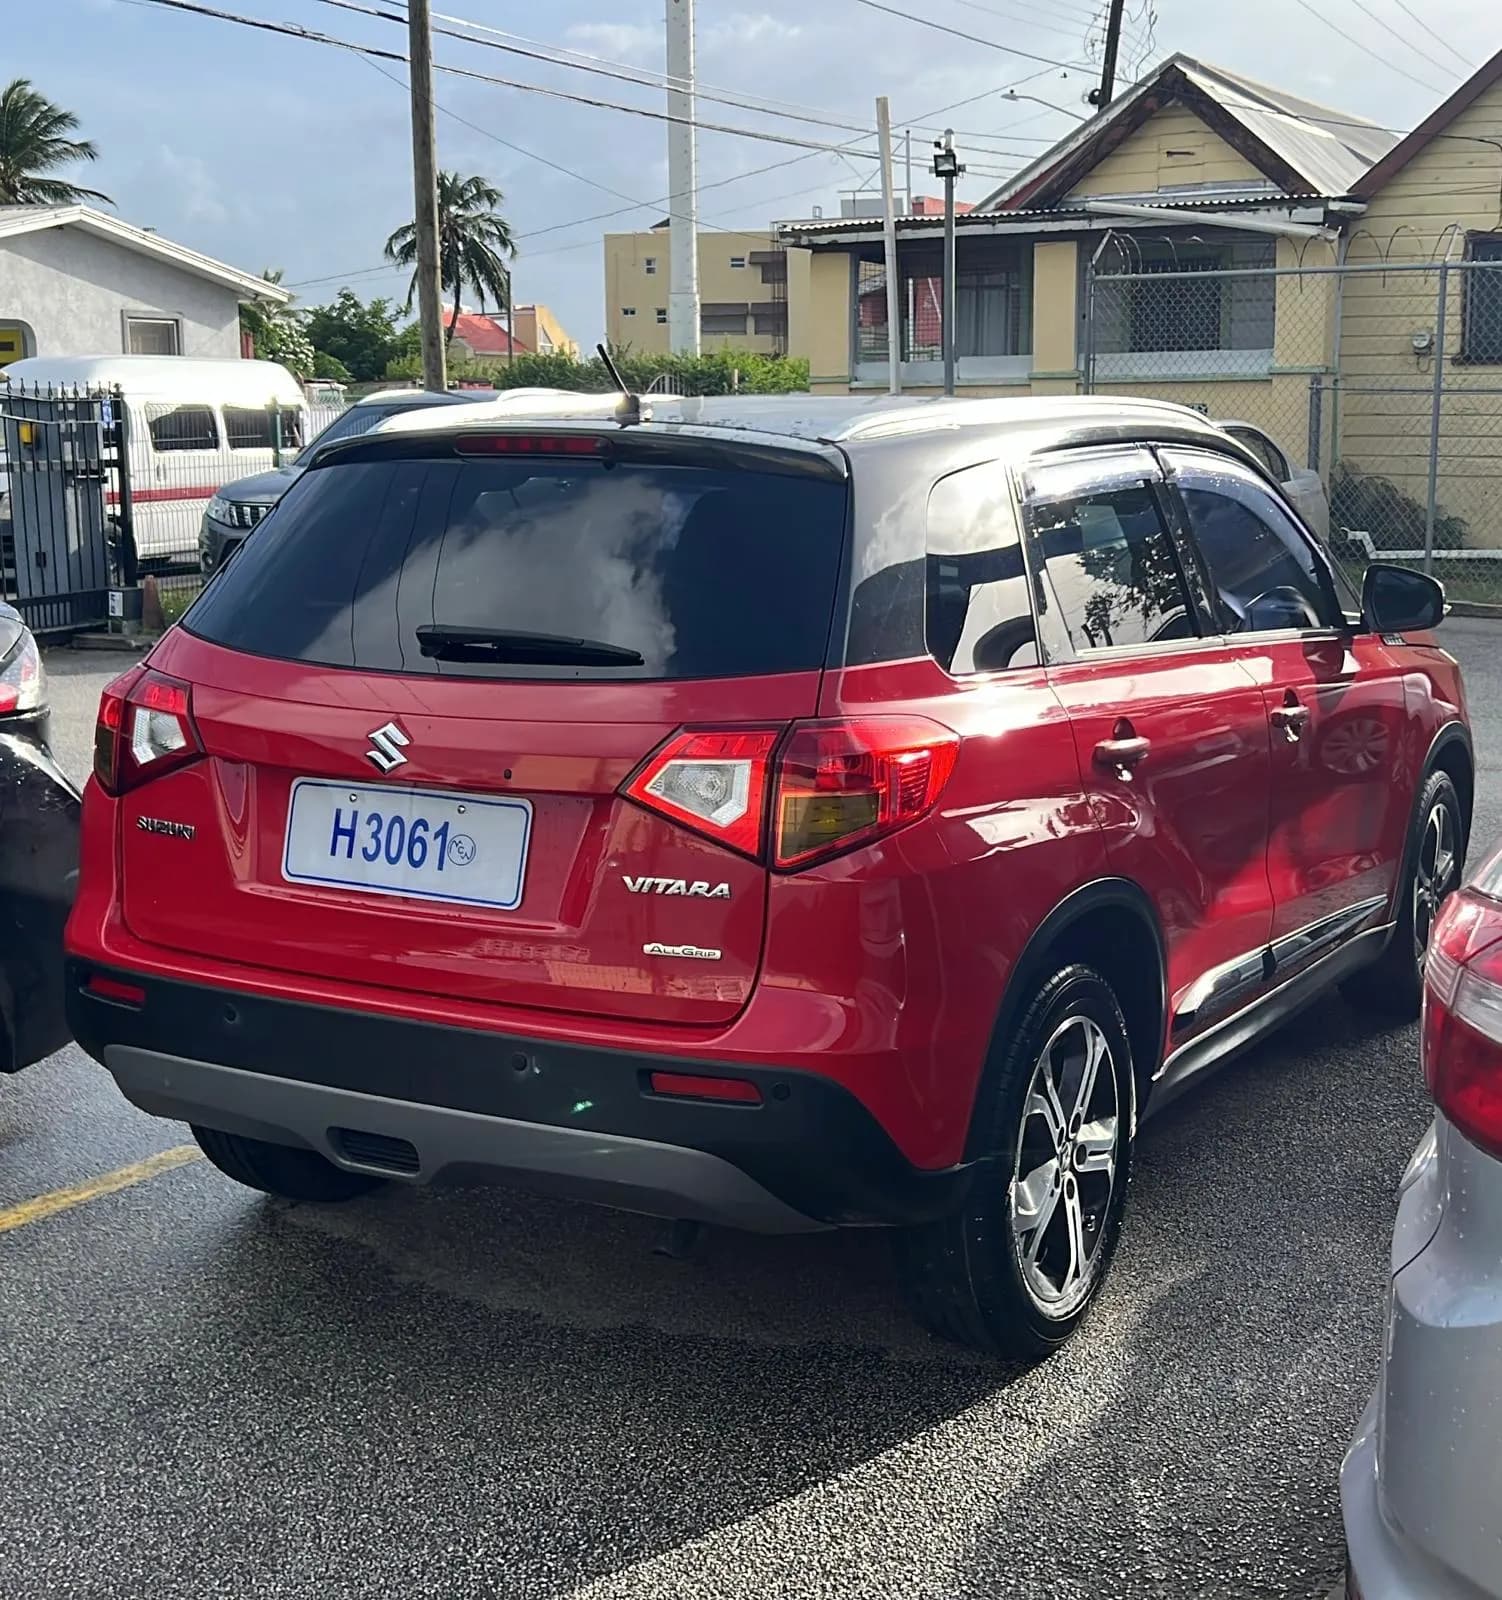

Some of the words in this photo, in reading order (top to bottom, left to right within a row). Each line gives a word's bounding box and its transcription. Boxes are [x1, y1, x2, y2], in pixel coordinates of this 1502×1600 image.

[136, 815, 195, 840] SUZUKI
[330, 808, 450, 871] H3061
[622, 876, 730, 898] VITARA
